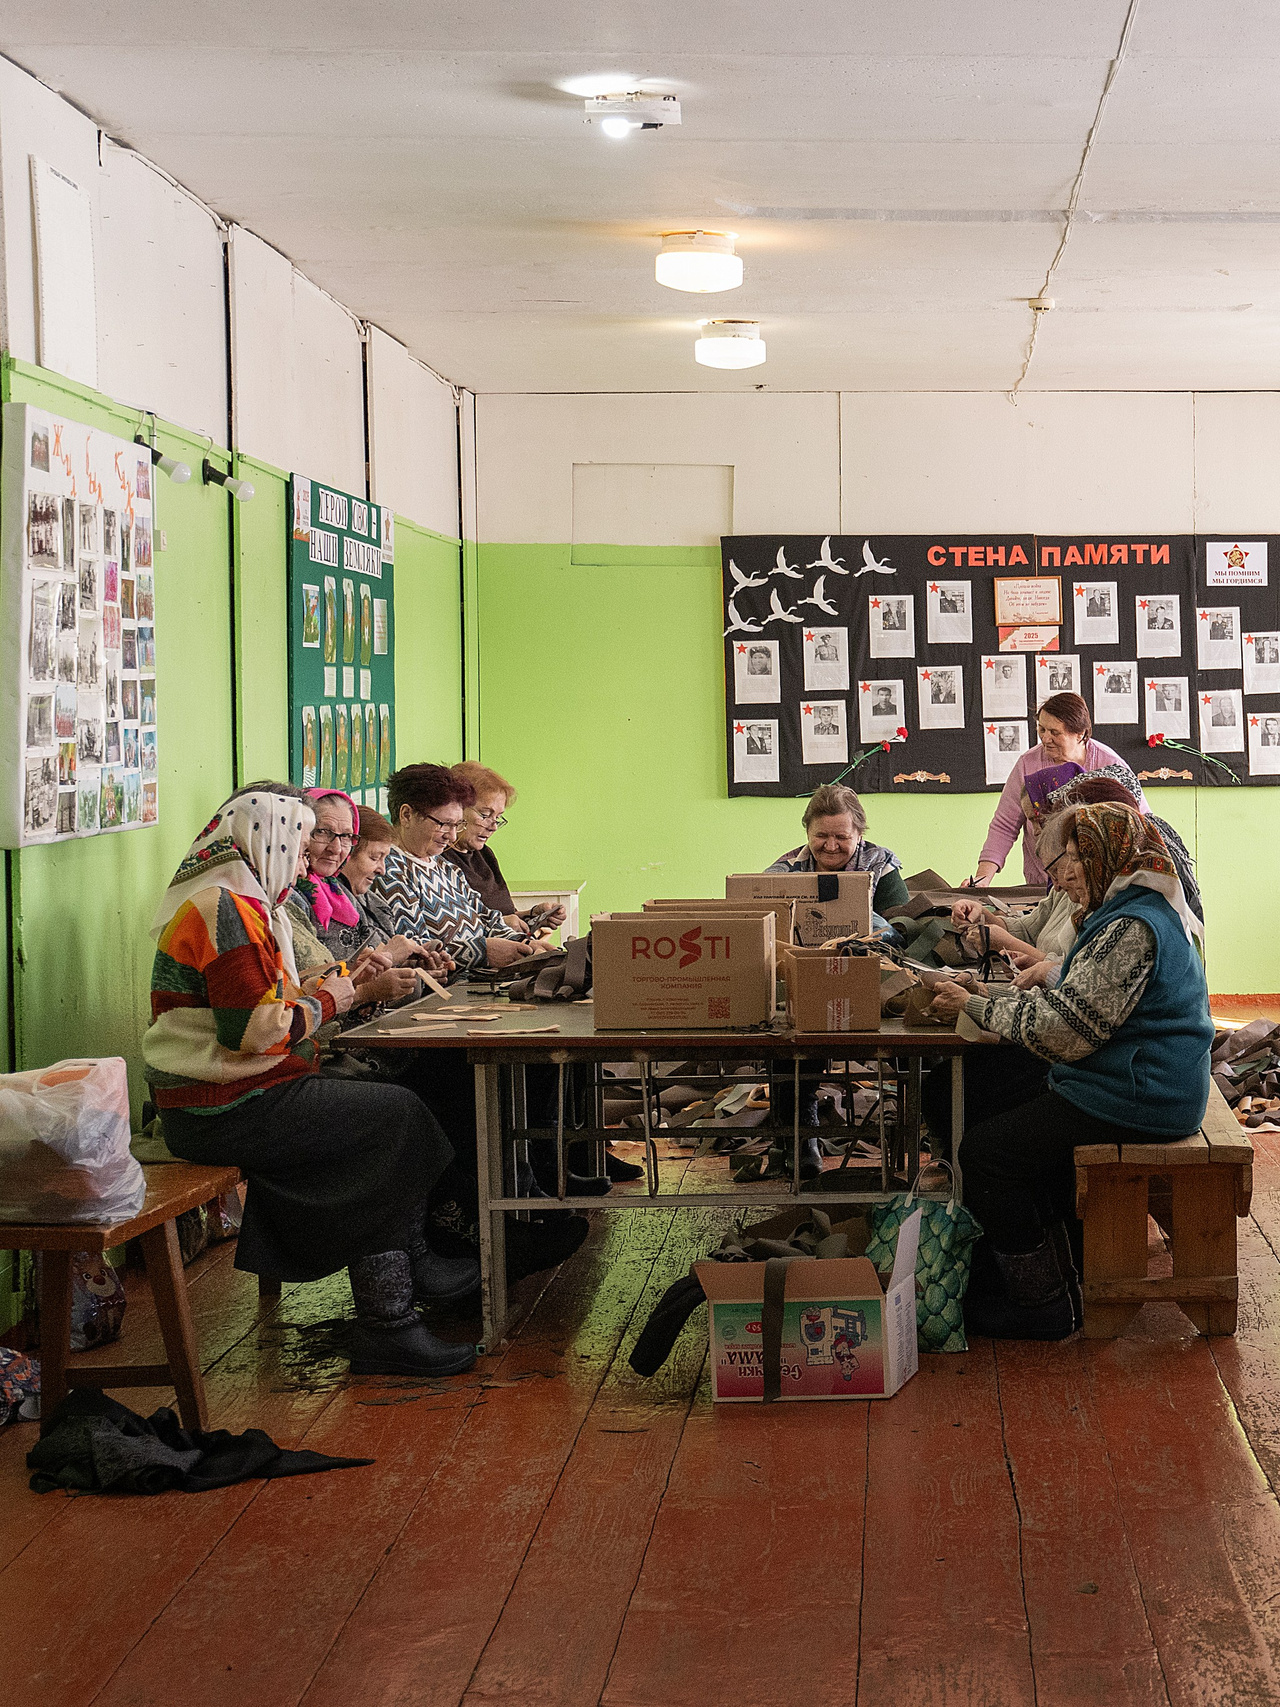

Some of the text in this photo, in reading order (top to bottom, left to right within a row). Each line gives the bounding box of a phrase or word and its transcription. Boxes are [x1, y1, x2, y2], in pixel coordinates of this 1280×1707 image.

[320, 490, 348, 527] ГЕРОИ
[353, 502, 368, 534] СВО
[310, 529, 338, 564] НАШИ
[344, 539, 381, 576] ЗЕМЛЯКИ
[927, 544, 1170, 567] СТЕНА ПАМЯТИ
[631, 925, 731, 969] ROSTI
[632, 975, 731, 983] ТОРГОВО-ПРОМЫШЛЕННАЯ
[721, 1351, 787, 1365] "АМА"
[738, 1365, 803, 1380] Сечки
